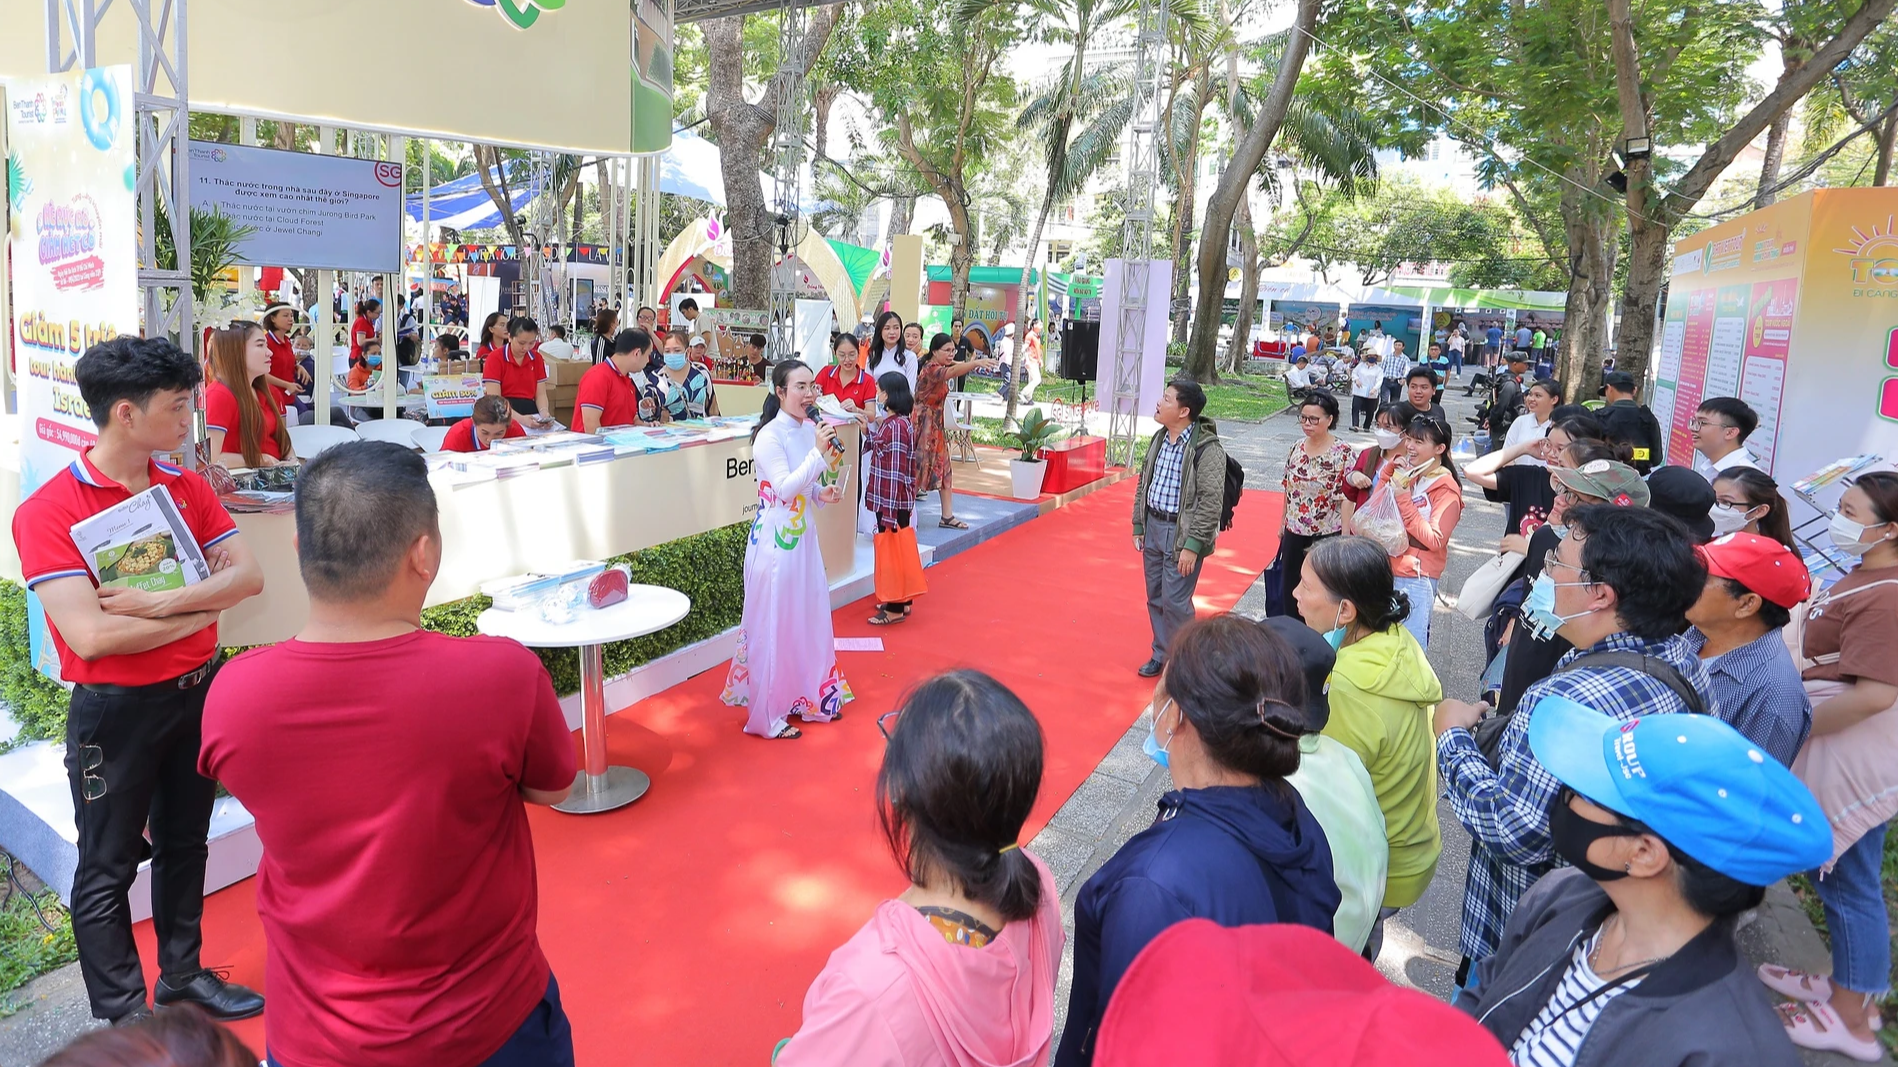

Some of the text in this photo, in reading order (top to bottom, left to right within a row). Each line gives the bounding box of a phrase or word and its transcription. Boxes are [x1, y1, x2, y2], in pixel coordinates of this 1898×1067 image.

[380, 164, 402, 179] SG
[214, 178, 234, 187] Thác
[237, 181, 259, 189] nước
[262, 183, 283, 193] trong
[286, 185, 300, 193] nhà
[319, 188, 332, 197] đây
[342, 190, 380, 201] Singapore
[235, 188, 257, 198] được
[260, 191, 277, 199] xem
[296, 194, 313, 202] nhất
[221, 201, 240, 210] Thác
[243, 203, 263, 211] nước
[265, 204, 275, 212] tại
[277, 206, 297, 214] vườn
[299, 208, 316, 216] chim
[318, 210, 343, 219] Jurong
[360, 213, 376, 221] Park
[243, 213, 263, 221] nước
[277, 216, 298, 224] Cloud
[300, 218, 324, 226] Forest
[274, 225, 295, 233] Jewel
[296, 227, 323, 237] Changi
[20, 310, 65, 353] Giảm
[69, 319, 81, 356] 5
[29, 357, 51, 380] tour
[53, 386, 92, 420] Israe
